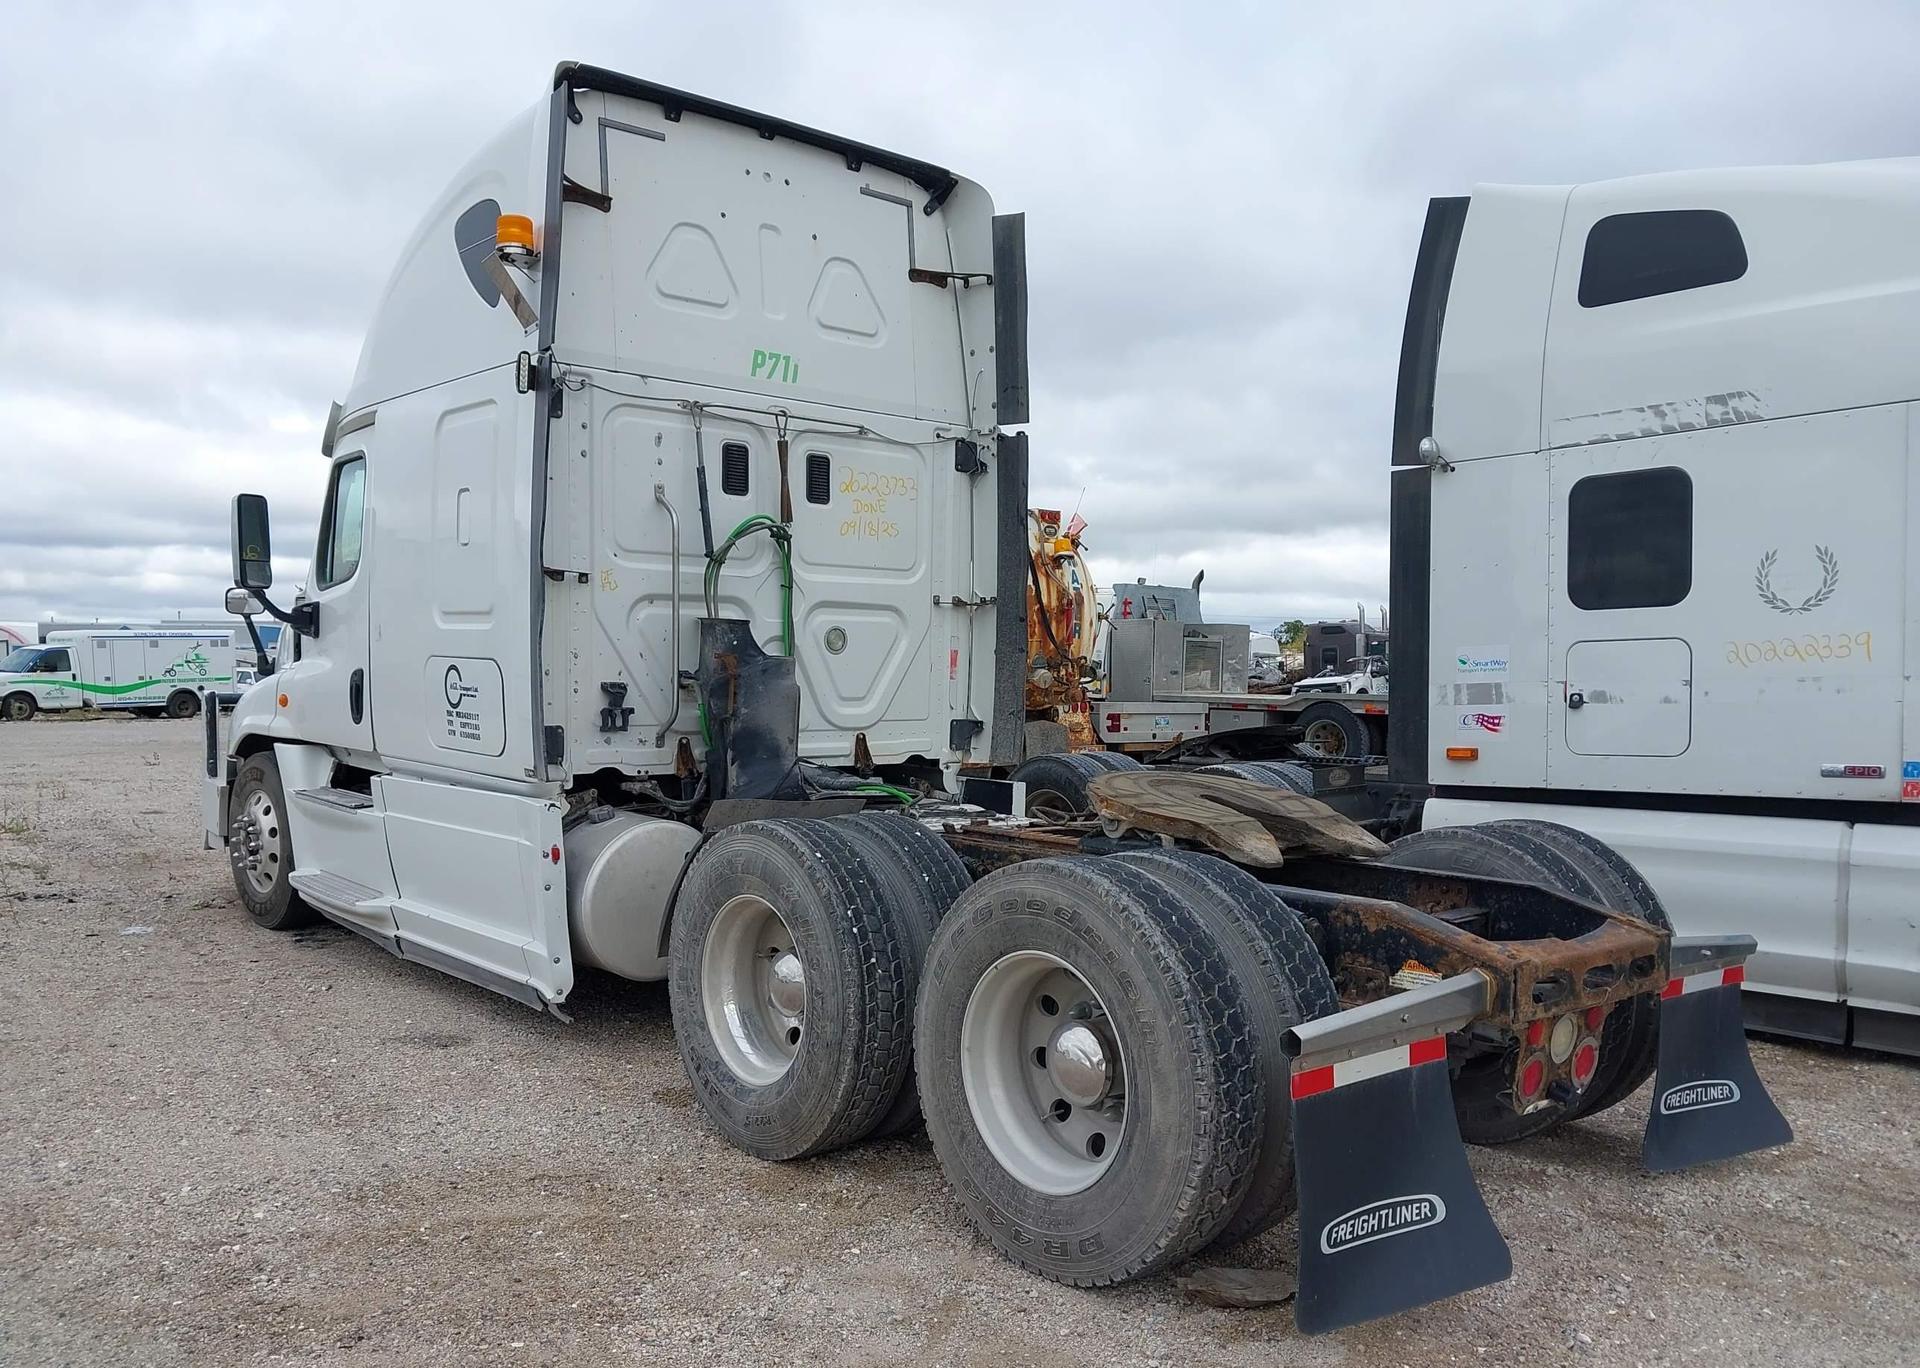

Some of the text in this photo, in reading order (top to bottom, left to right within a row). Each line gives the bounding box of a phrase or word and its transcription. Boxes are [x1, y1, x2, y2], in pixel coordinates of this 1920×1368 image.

[1473, 659, 1508, 668] SmartWay
[1725, 631, 1873, 668] 20222339
[1666, 1085, 1731, 1107] FREIGHTLINER
[1330, 1201, 1432, 1243] FREIGHTLINER
